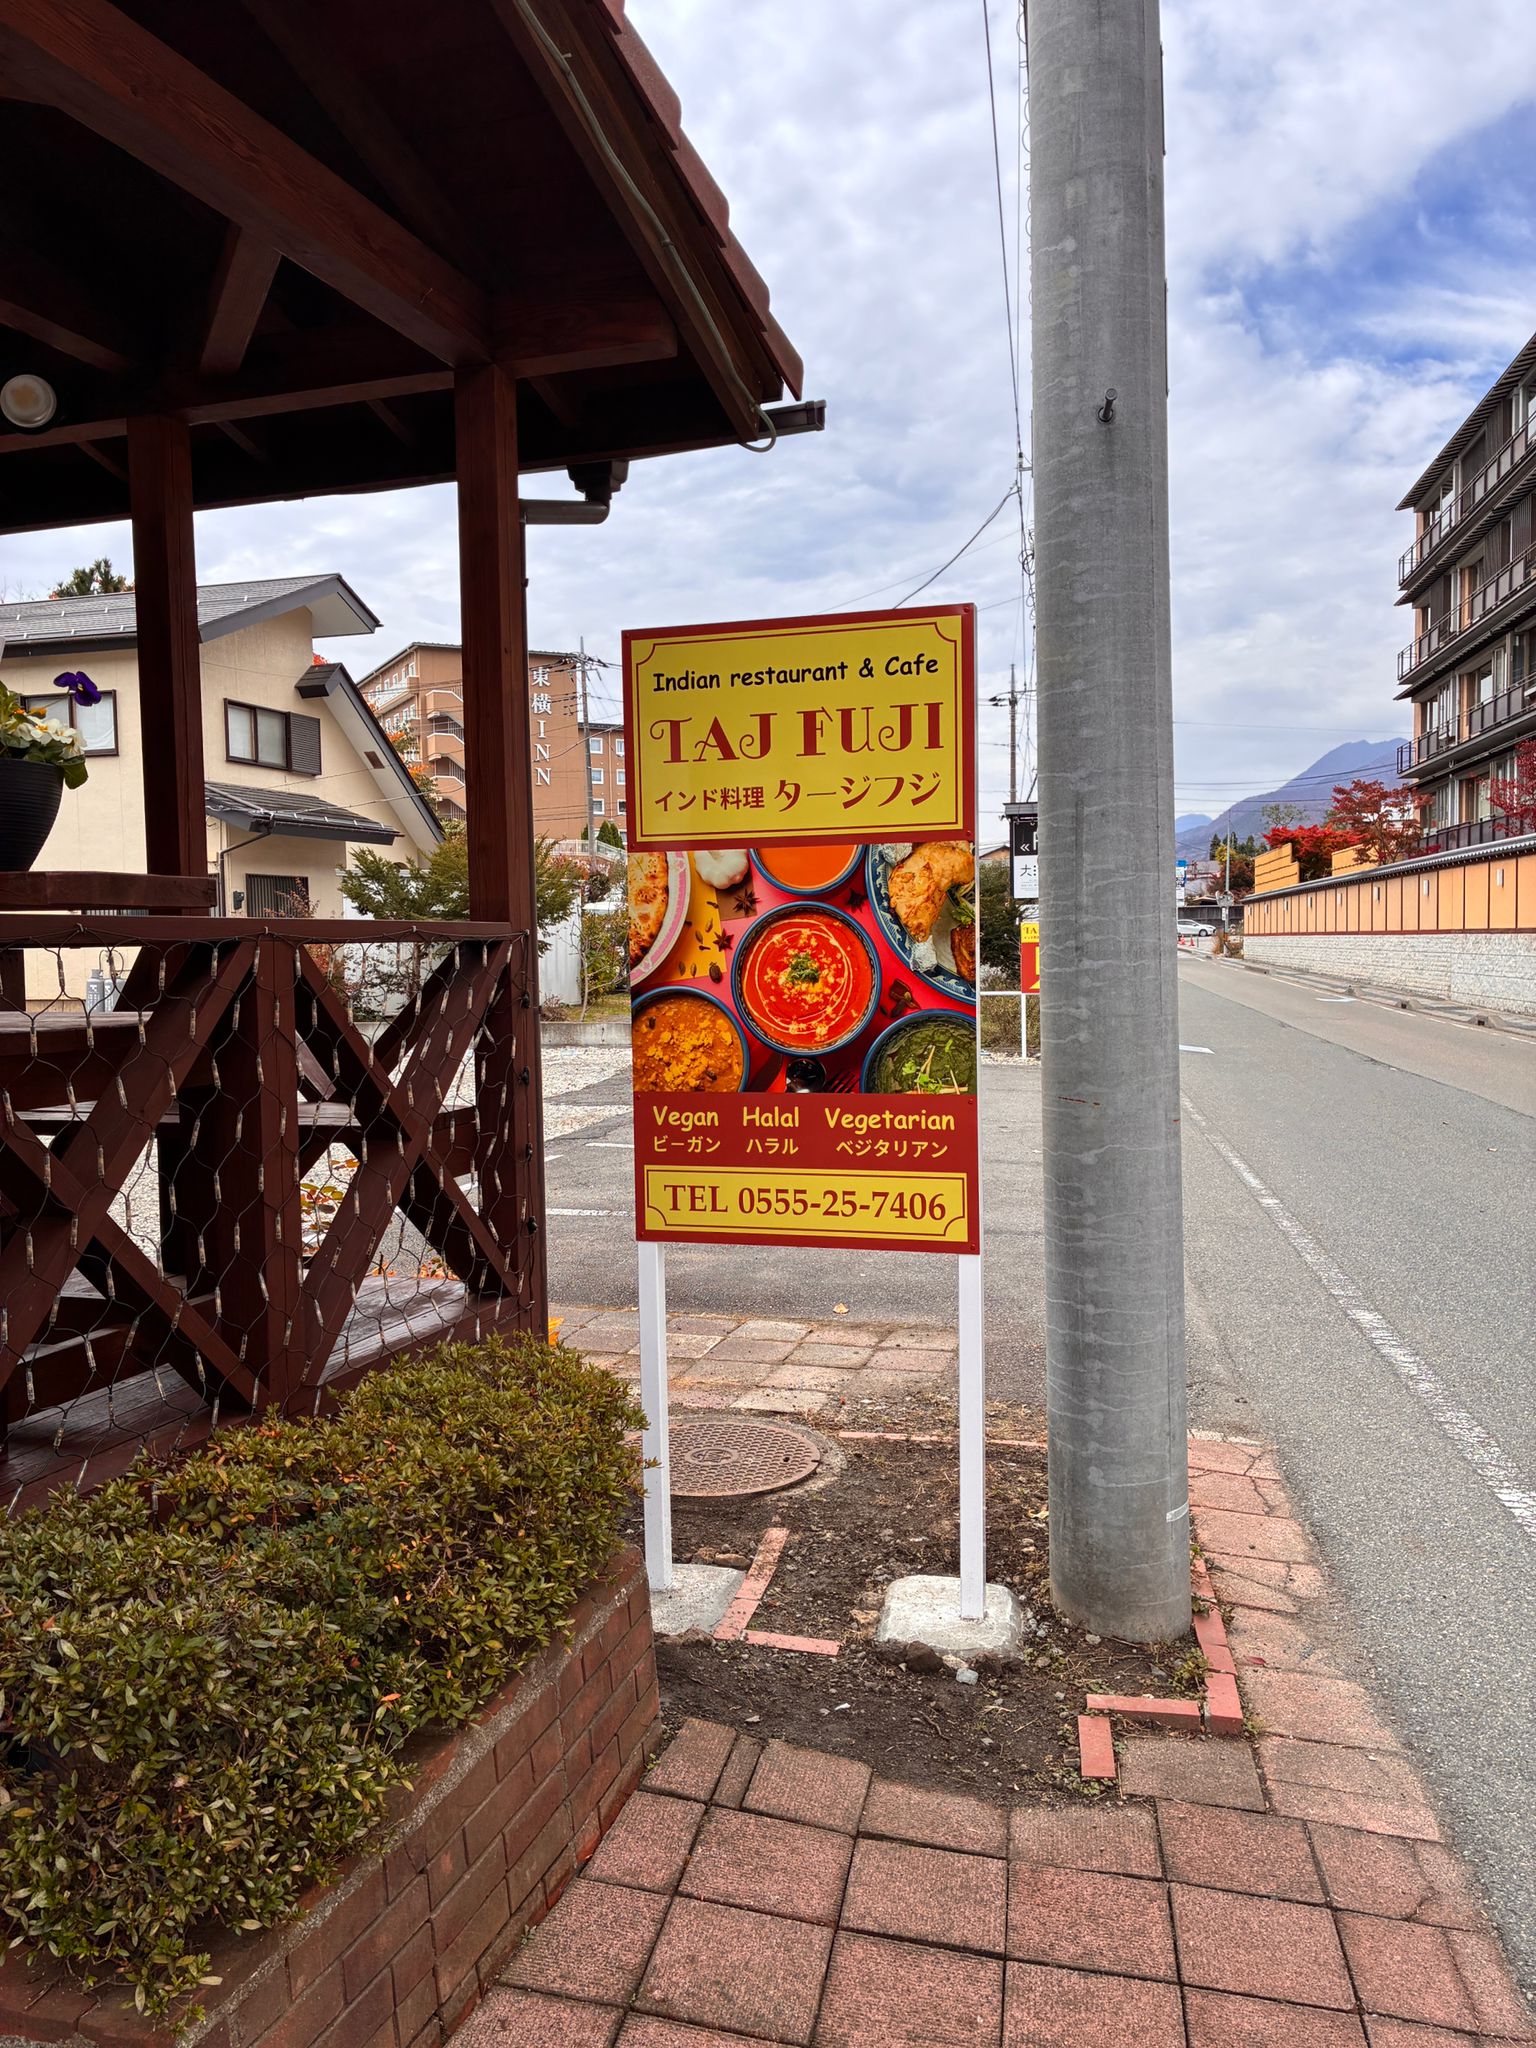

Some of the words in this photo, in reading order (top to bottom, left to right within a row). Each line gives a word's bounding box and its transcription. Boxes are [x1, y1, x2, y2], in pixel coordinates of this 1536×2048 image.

[653, 670, 720, 691] Indian
[730, 662, 849, 687] restaurant
[859, 658, 875, 678] &
[885, 653, 939, 676] Cafe
[650, 713, 778, 763] TAJ
[796, 702, 944, 757] FUJI
[654, 786, 765, 812] インド料理
[774, 771, 941, 812] タージフジ
[653, 1106, 719, 1131] Vegan
[743, 1106, 799, 1128] Halal
[824, 1108, 955, 1135] Vegetarian
[653, 1135, 721, 1153] ビーガン
[746, 1138, 799, 1155] ハラル
[836, 1140, 948, 1158] ベジタリアン
[664, 1184, 728, 1212] TEL
[738, 1187, 946, 1220] 0555-25-7406
